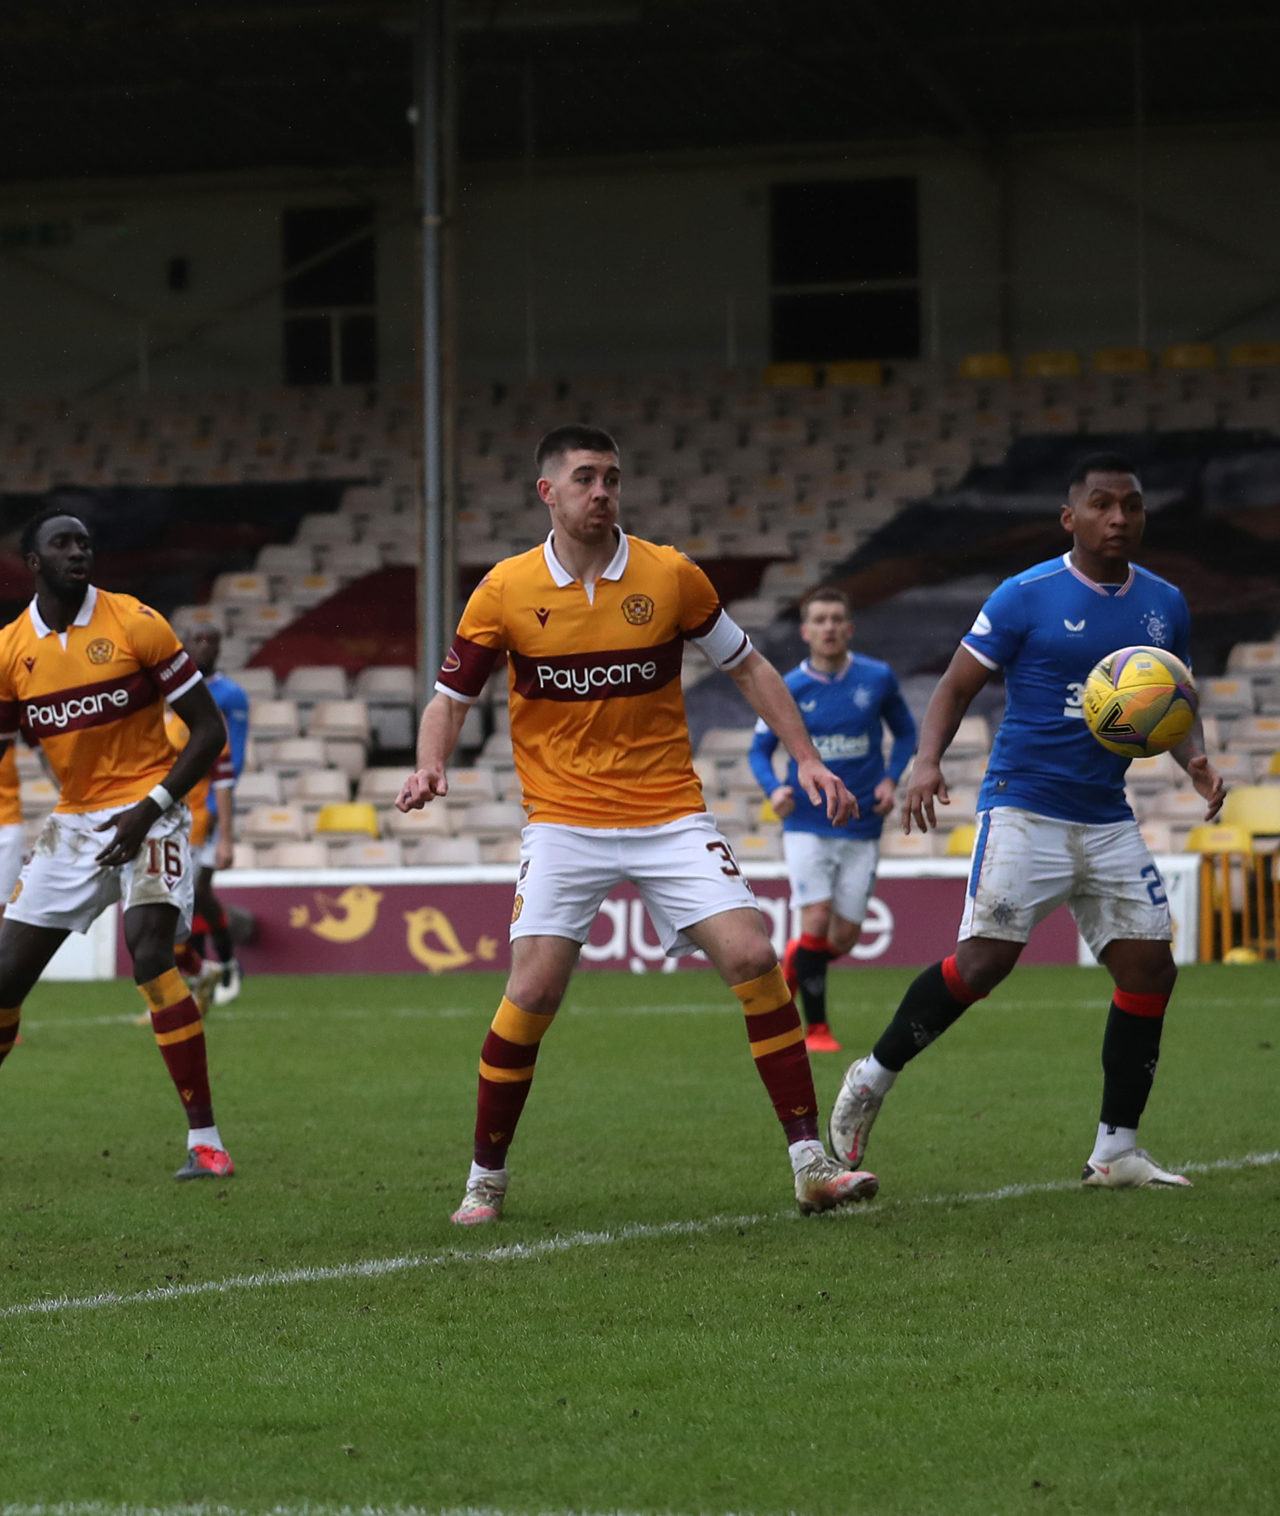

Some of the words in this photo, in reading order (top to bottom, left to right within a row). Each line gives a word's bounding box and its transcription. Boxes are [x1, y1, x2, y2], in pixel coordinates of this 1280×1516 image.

[537, 661, 656, 695] Paycare
[26, 689, 129, 728] Paycare
[146, 838, 182, 877] 16
[706, 841, 740, 876] 3
[1141, 864, 1167, 905] 2
